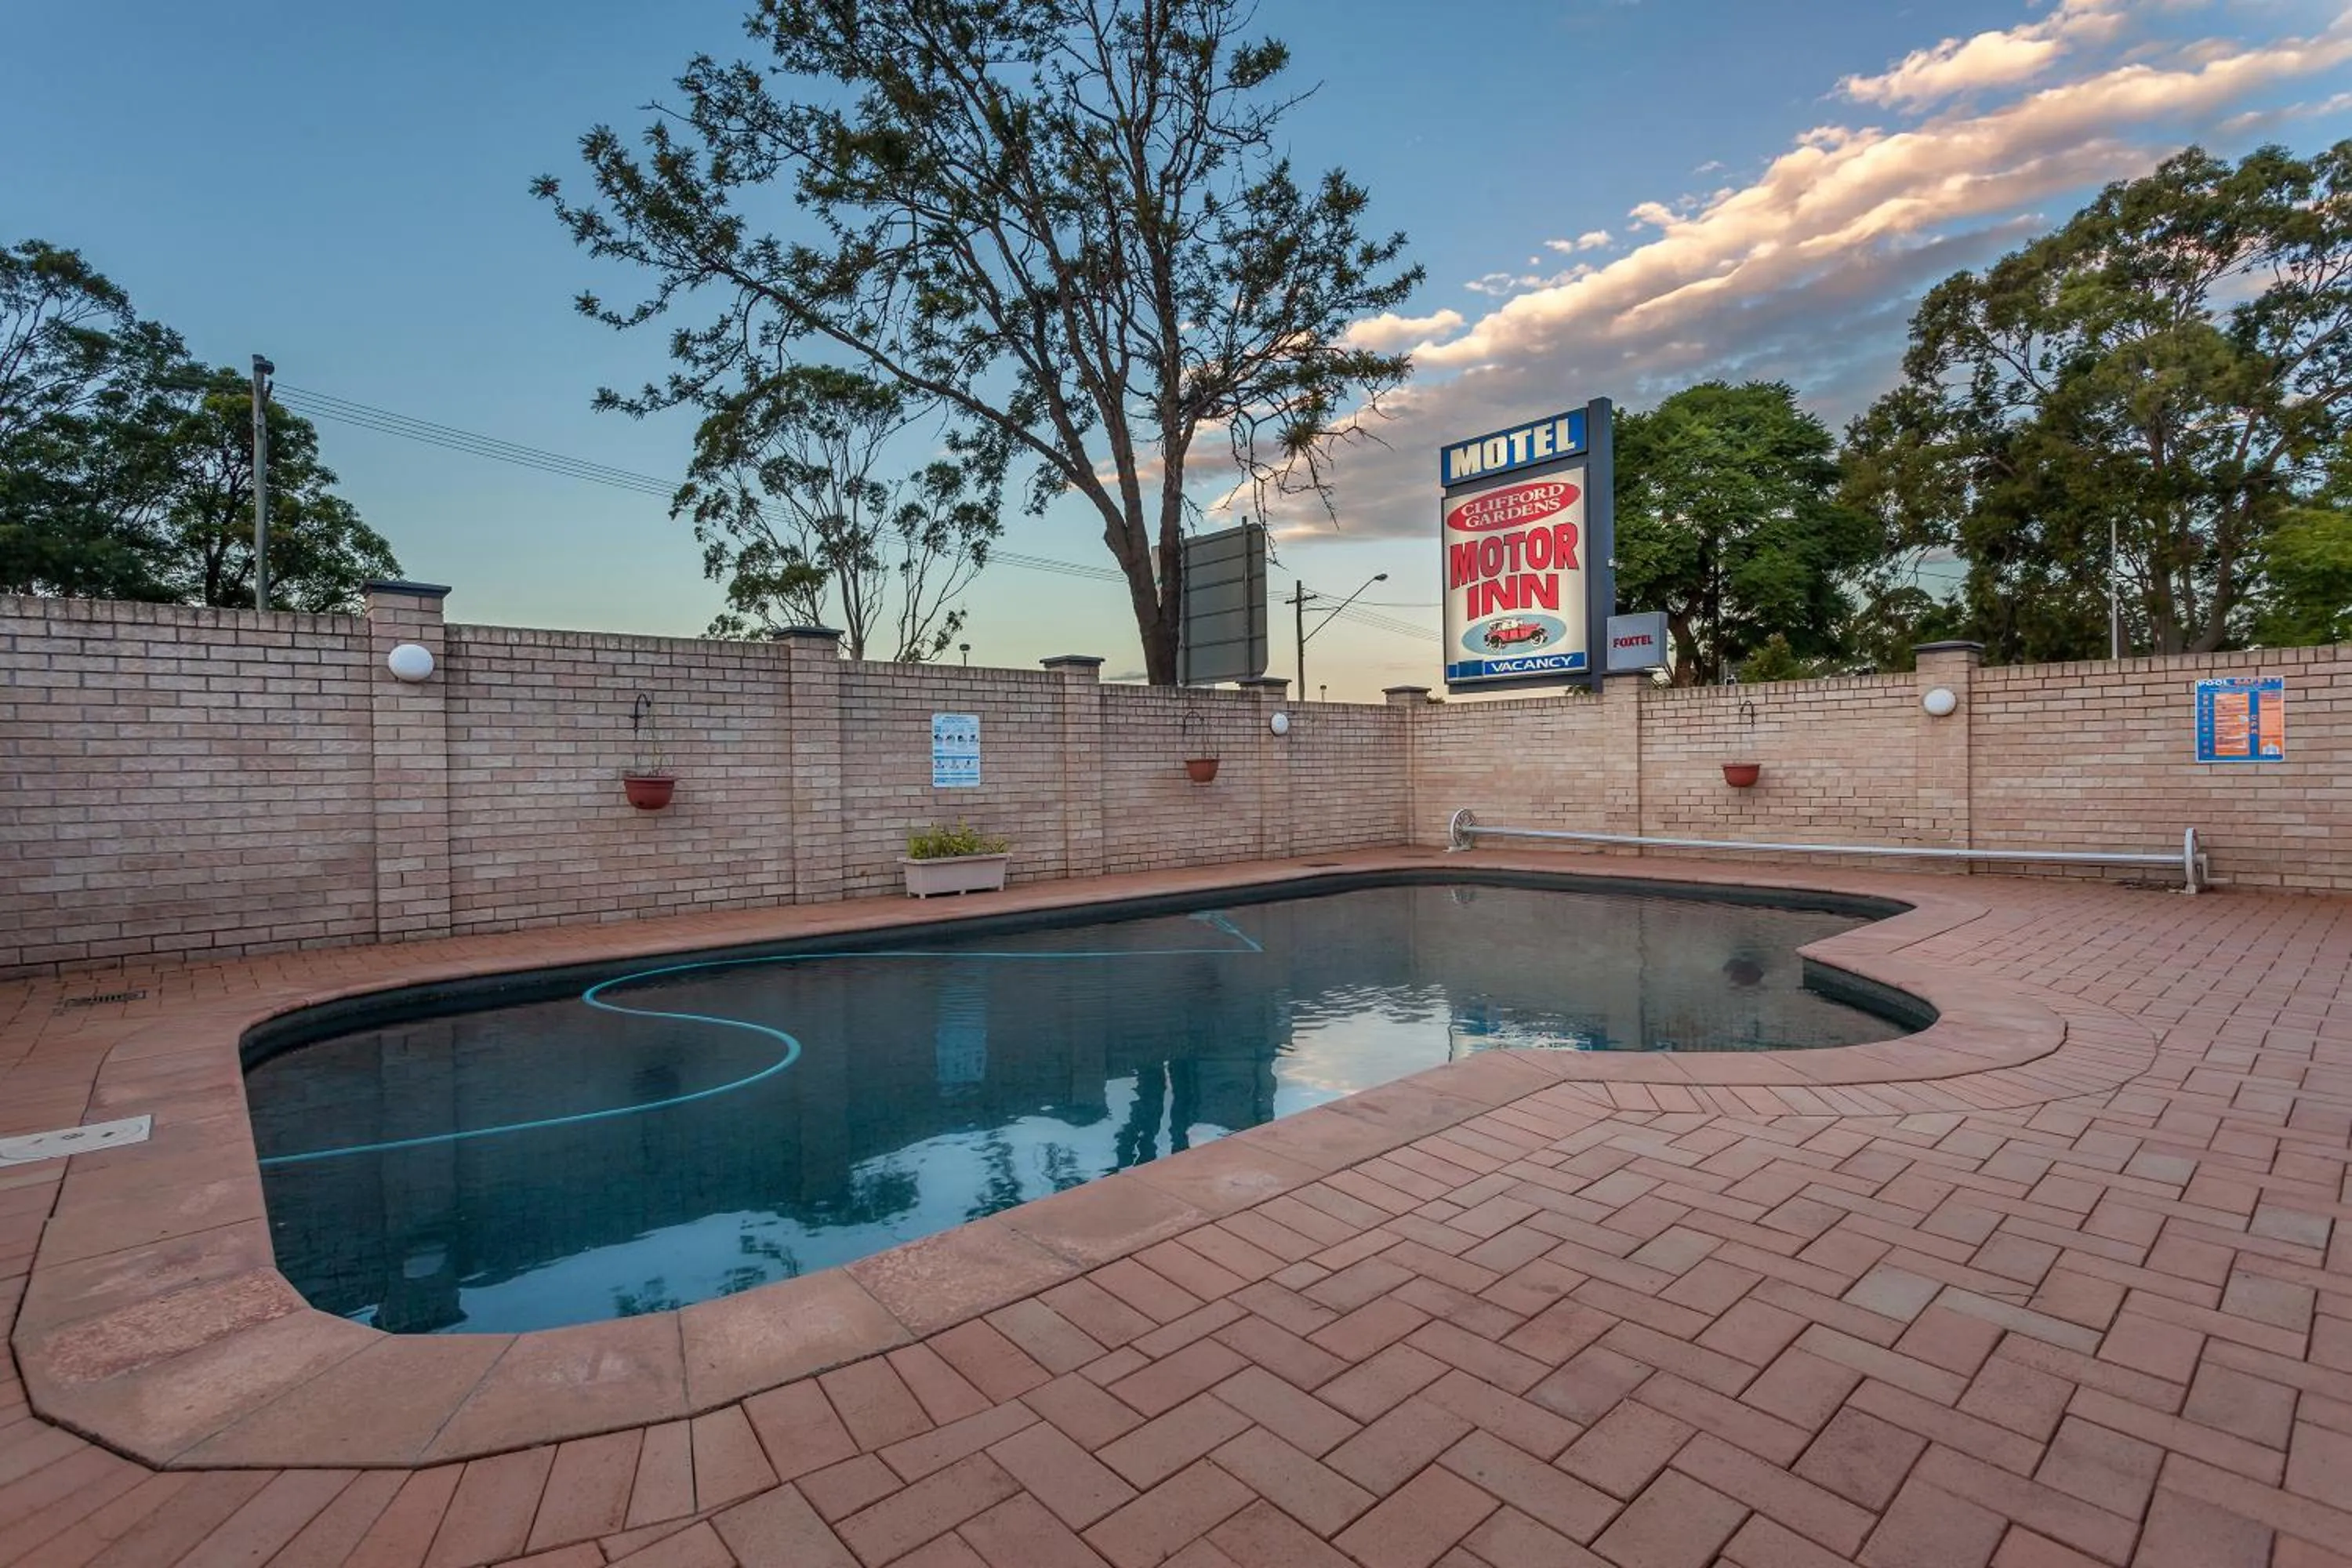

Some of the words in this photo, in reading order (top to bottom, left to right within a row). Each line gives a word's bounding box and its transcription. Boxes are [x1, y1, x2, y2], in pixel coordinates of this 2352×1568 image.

[1450, 418, 1575, 479] MOTEL
[1461, 484, 1565, 517] CLIFFORD
[1465, 497, 1561, 528] GARDENS
[1450, 522, 1579, 590] MOTOR
[1468, 573, 1559, 621] INN
[1613, 634, 1653, 648] FOXTEL
[1490, 655, 1573, 672] VACANCY
[2198, 678, 2227, 687] POOL
